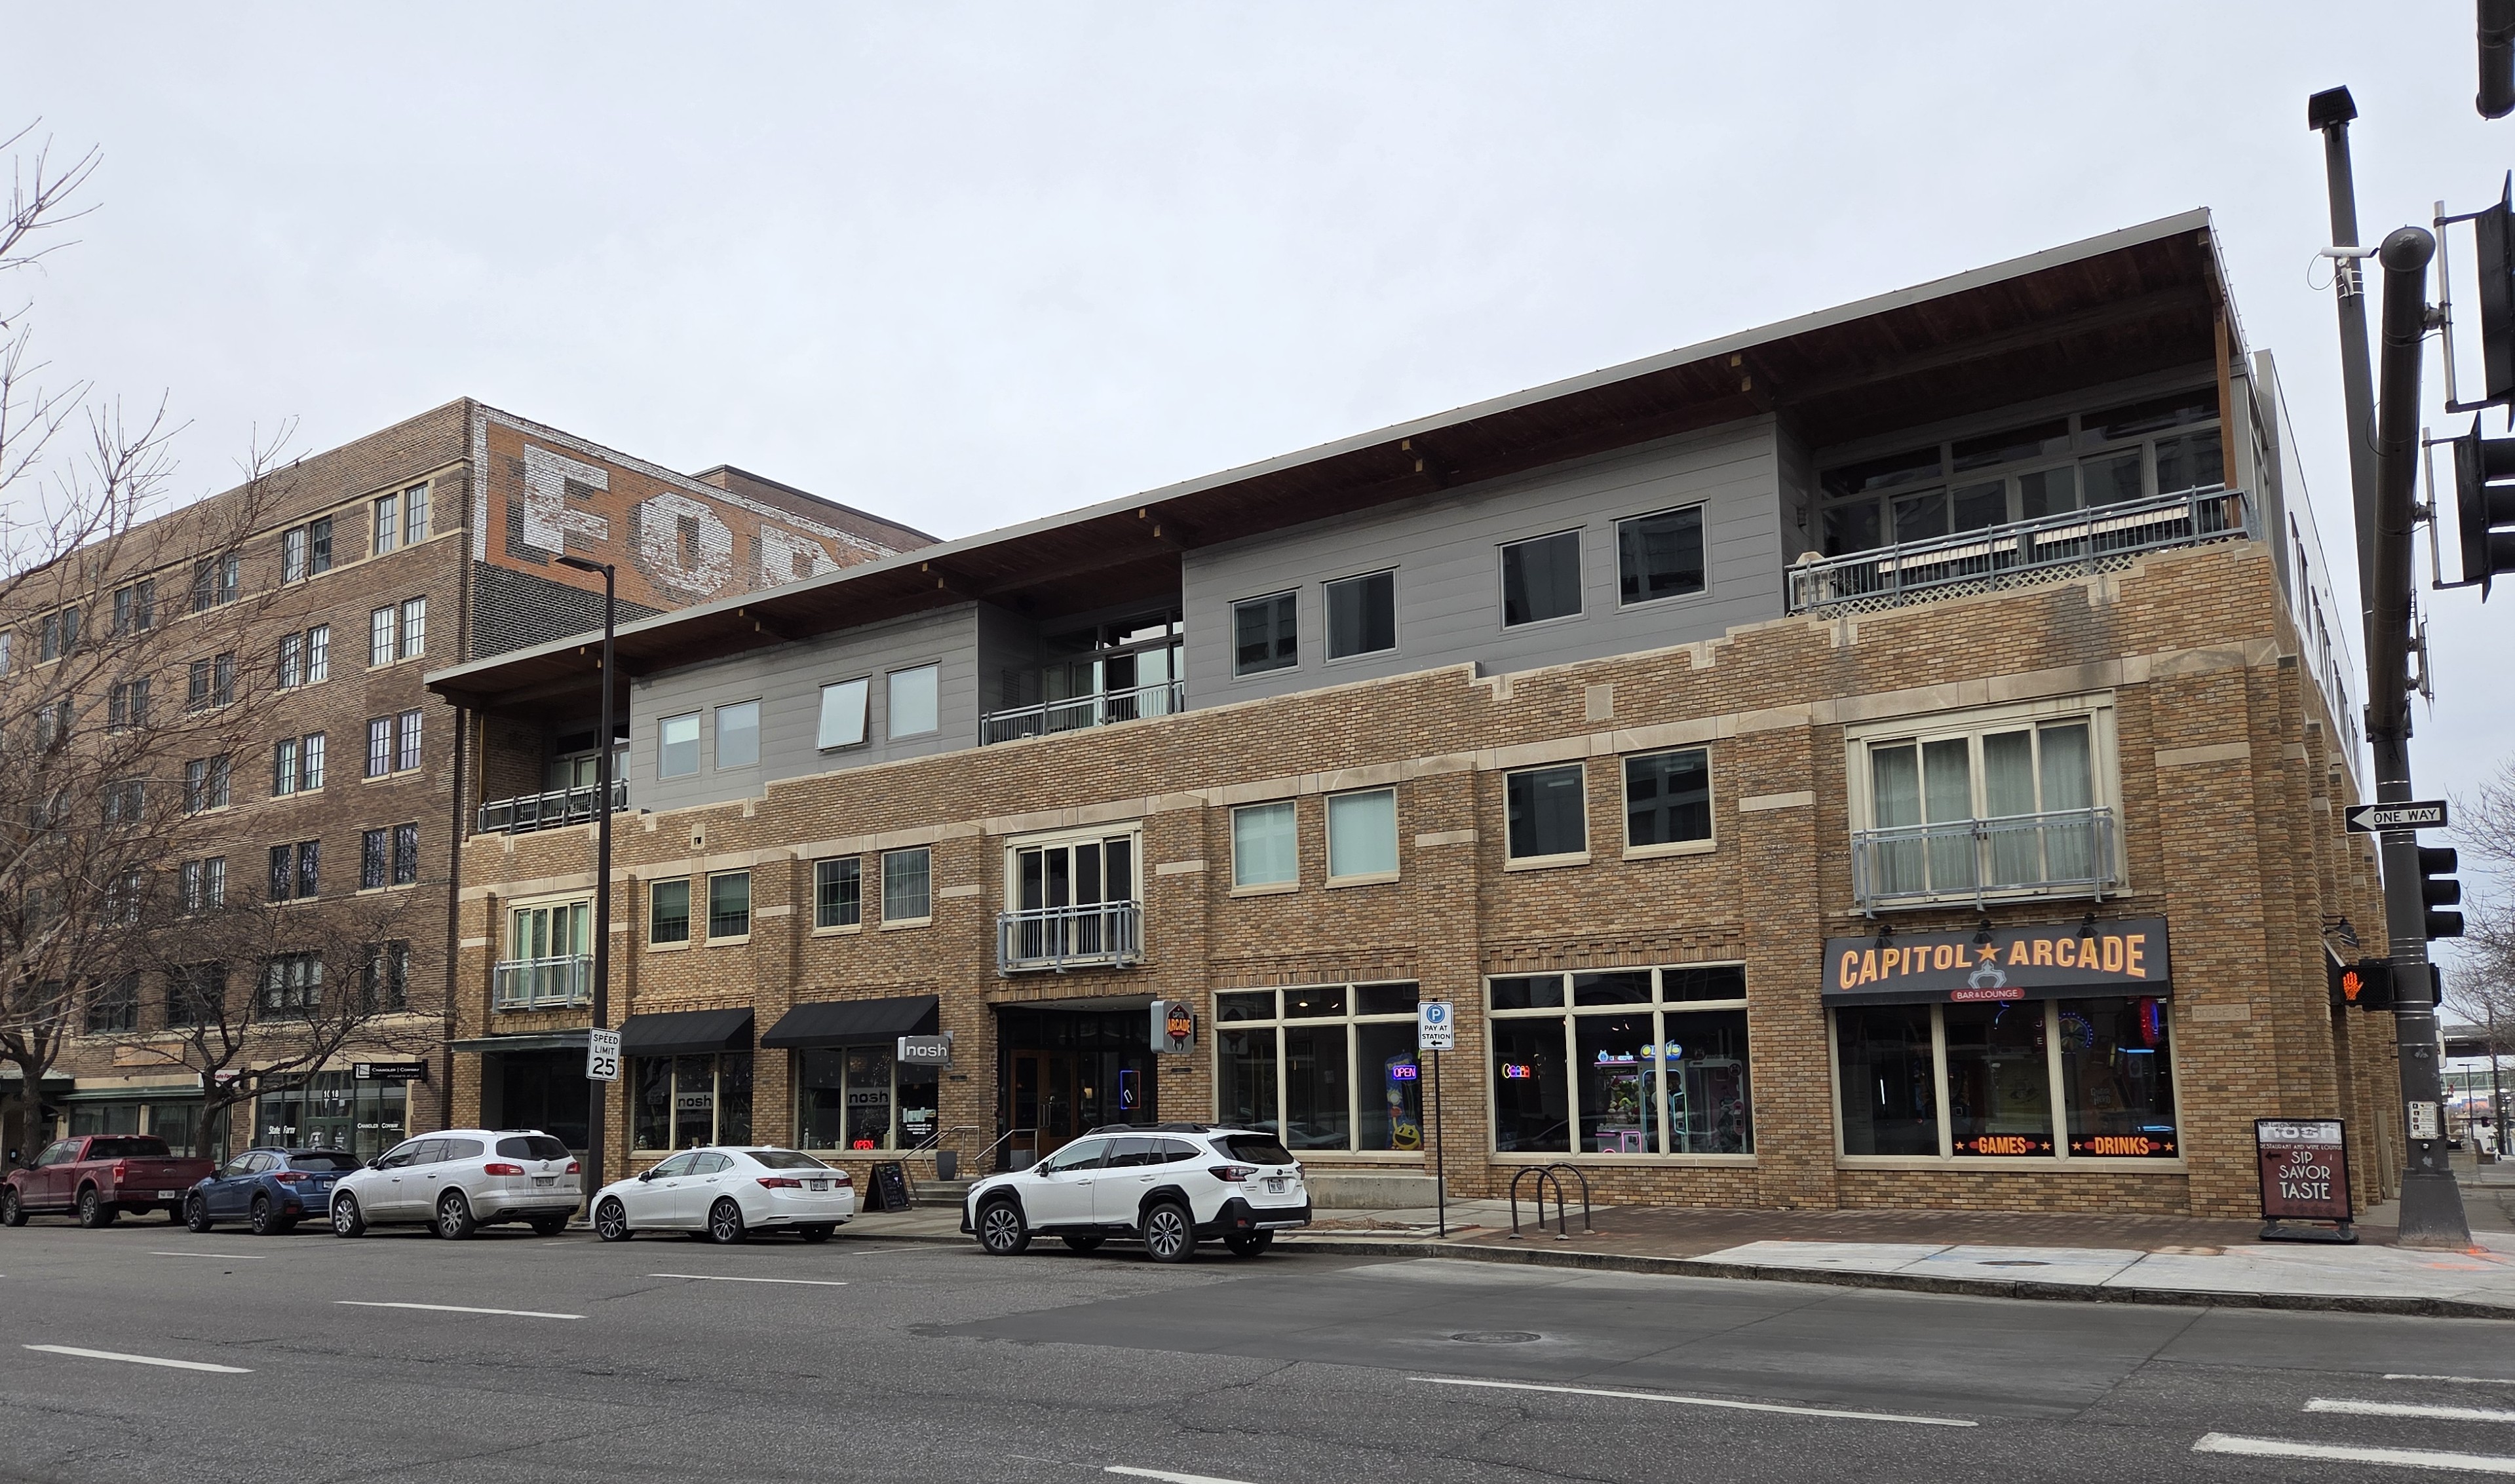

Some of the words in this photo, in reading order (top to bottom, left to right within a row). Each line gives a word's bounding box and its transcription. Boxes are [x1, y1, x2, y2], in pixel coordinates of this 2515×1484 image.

[2374, 812, 2401, 823] ONE
[2408, 809, 2436, 820] WAY
[1839, 944, 1972, 990] CAPITOL
[2007, 934, 2147, 978] ARCADE
[1432, 1009, 1440, 1020] P
[2195, 1008, 2229, 1018] DODGE
[2235, 1007, 2247, 1017] ST
[1168, 1019, 1191, 1033] ARCADE
[594, 1034, 618, 1044] SPEED
[595, 1045, 615, 1056] LIMIT
[906, 1043, 948, 1057] nosh
[592, 1057, 615, 1076] 25
[1394, 1067, 1415, 1078] OPEN
[678, 1095, 712, 1107] nosh
[849, 1089, 889, 1103] nosh
[853, 1140, 874, 1151] OPEN
[1978, 1137, 2026, 1154] GAMES
[2094, 1137, 2149, 1154] DRINKS
[2291, 1151, 2313, 1164] SIP
[2278, 1165, 2331, 1179] SAVOR
[2279, 1181, 2331, 1200] TASTE
